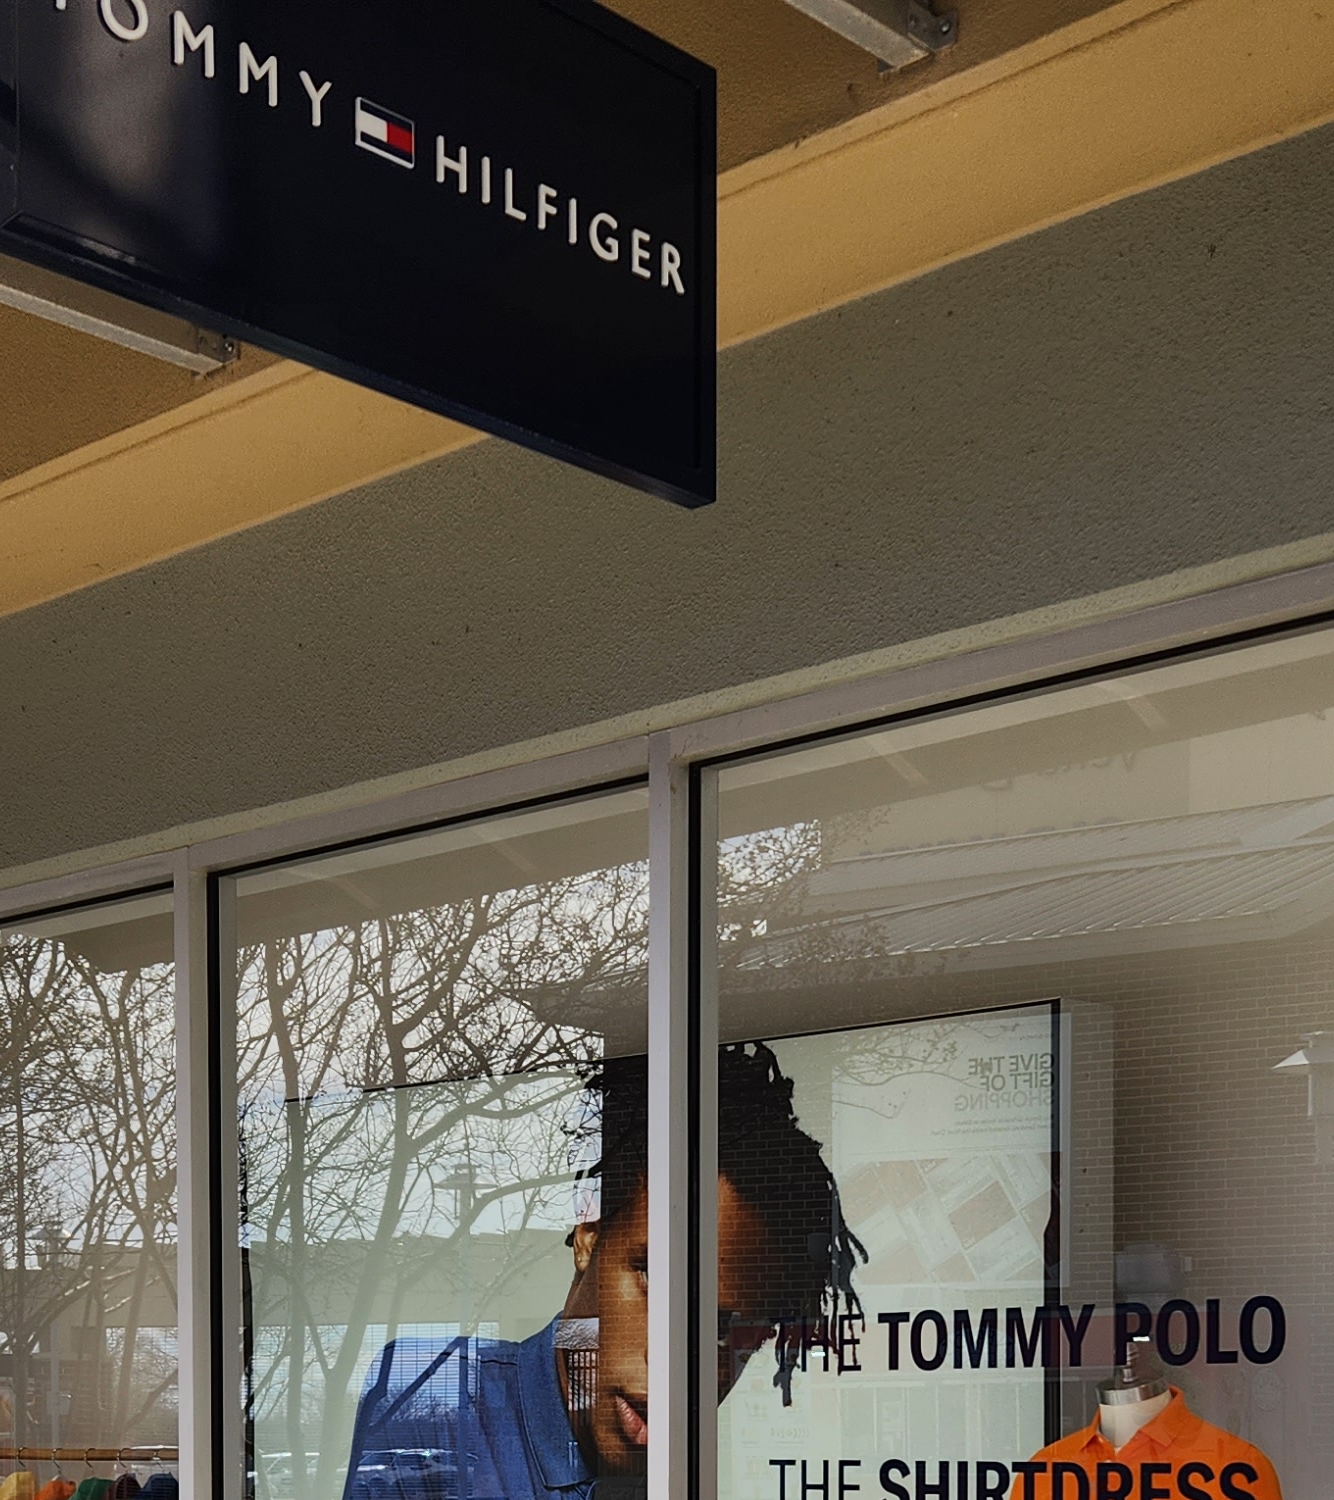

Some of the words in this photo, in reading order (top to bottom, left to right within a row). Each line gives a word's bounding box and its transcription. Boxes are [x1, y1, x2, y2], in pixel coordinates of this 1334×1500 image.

[55, 0, 331, 127] OMMY
[436, 135, 685, 294] HILFIGER
[769, 1313, 862, 1373] THE
[878, 1303, 1095, 1371] TOMMY
[1112, 1295, 1286, 1367] POLO
